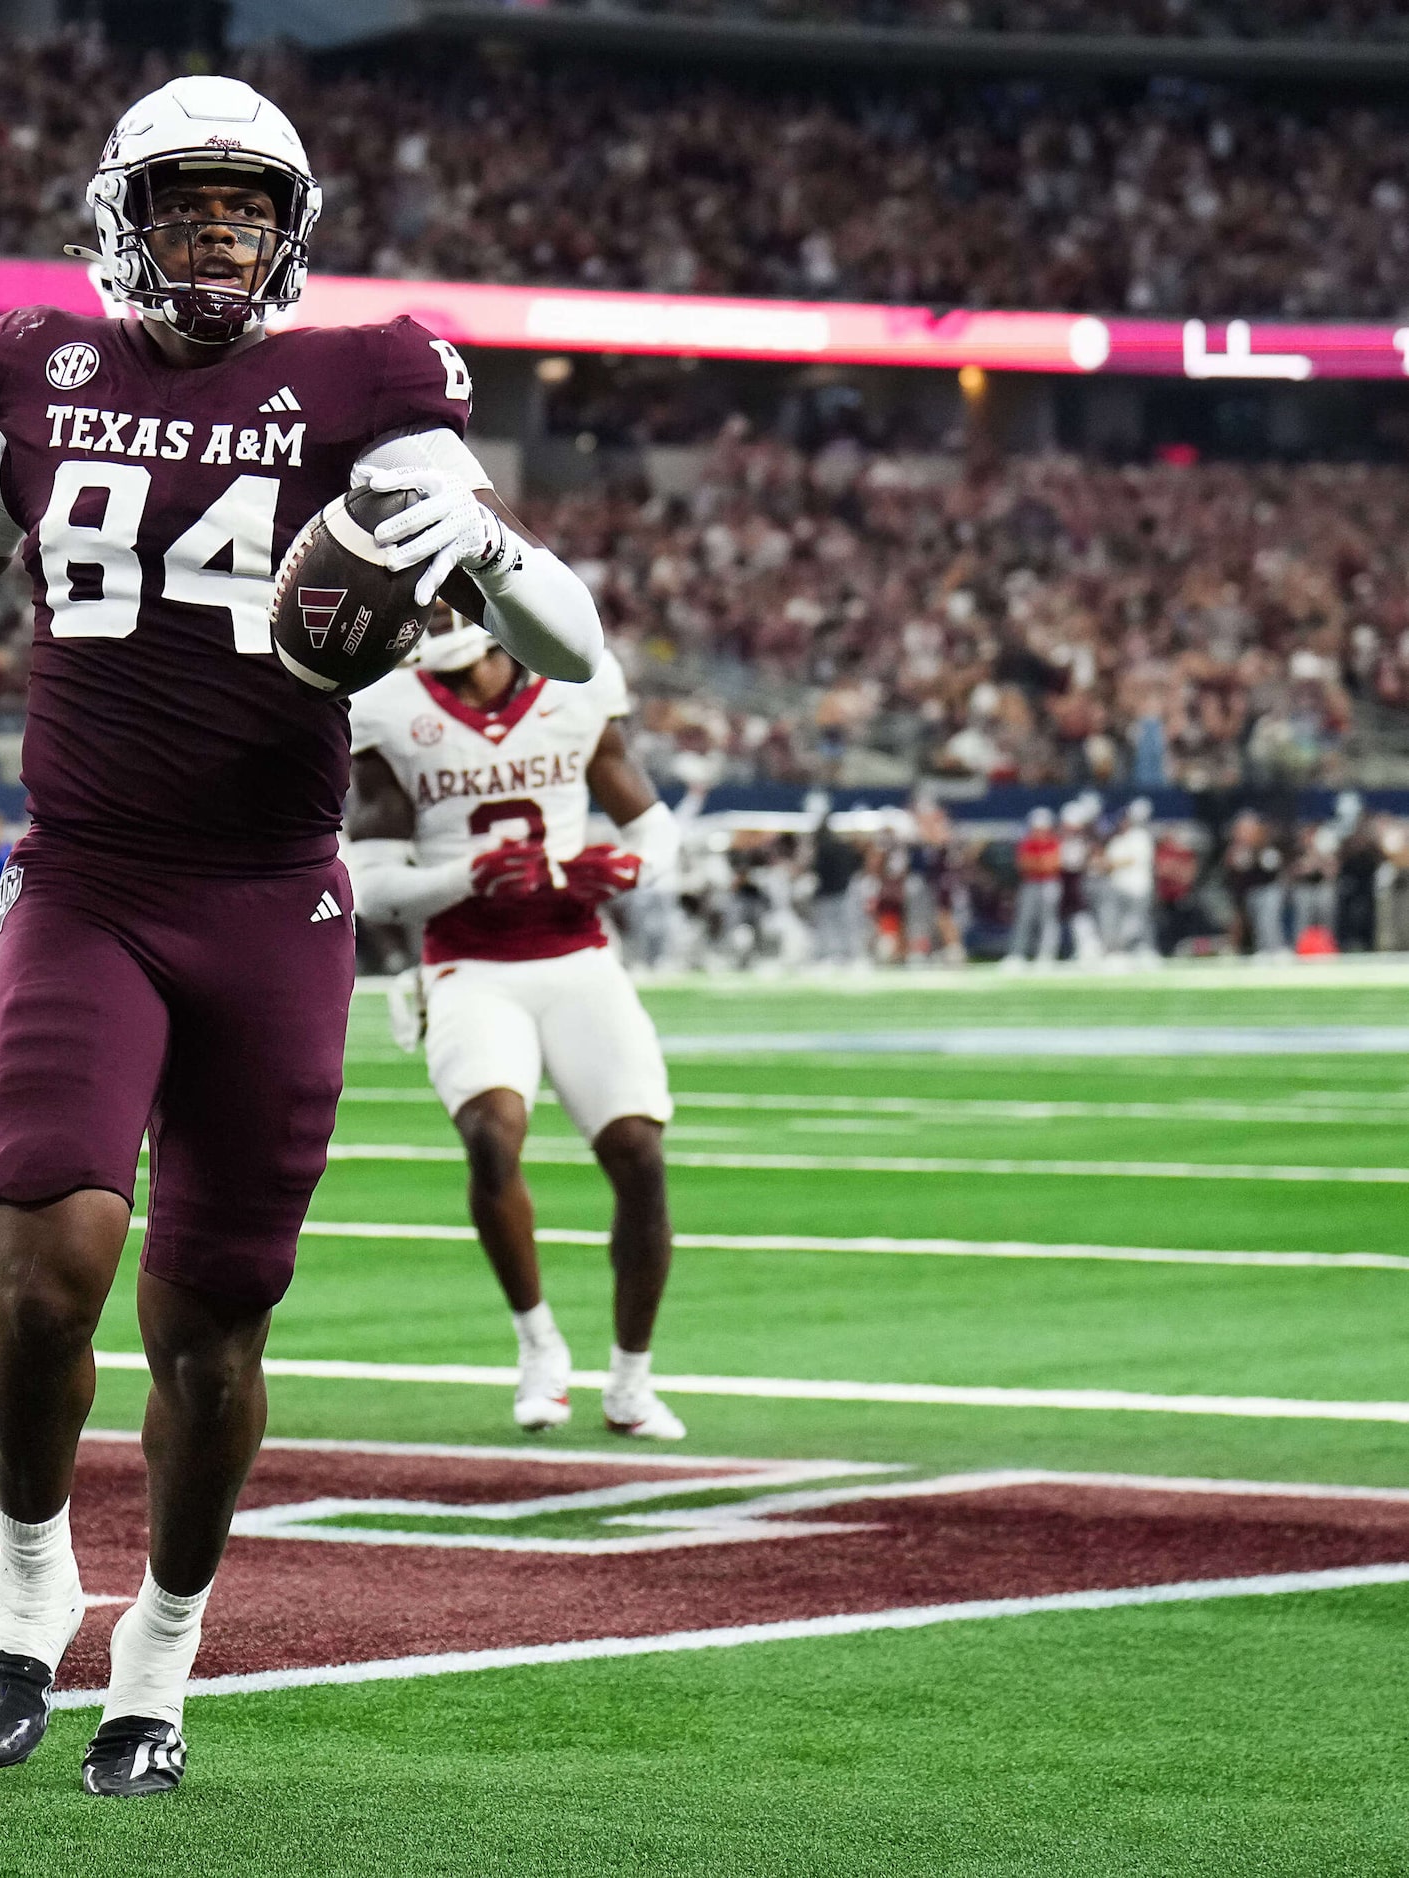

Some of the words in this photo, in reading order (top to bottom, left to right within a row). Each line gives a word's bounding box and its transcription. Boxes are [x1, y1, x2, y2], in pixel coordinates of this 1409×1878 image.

[48, 344, 98, 388] SEC
[45, 404, 194, 460] TEXAS
[199, 422, 306, 467] A&M
[38, 460, 281, 654] 84
[342, 604, 373, 656] DIME
[416, 750, 582, 803] ARKANSAS
